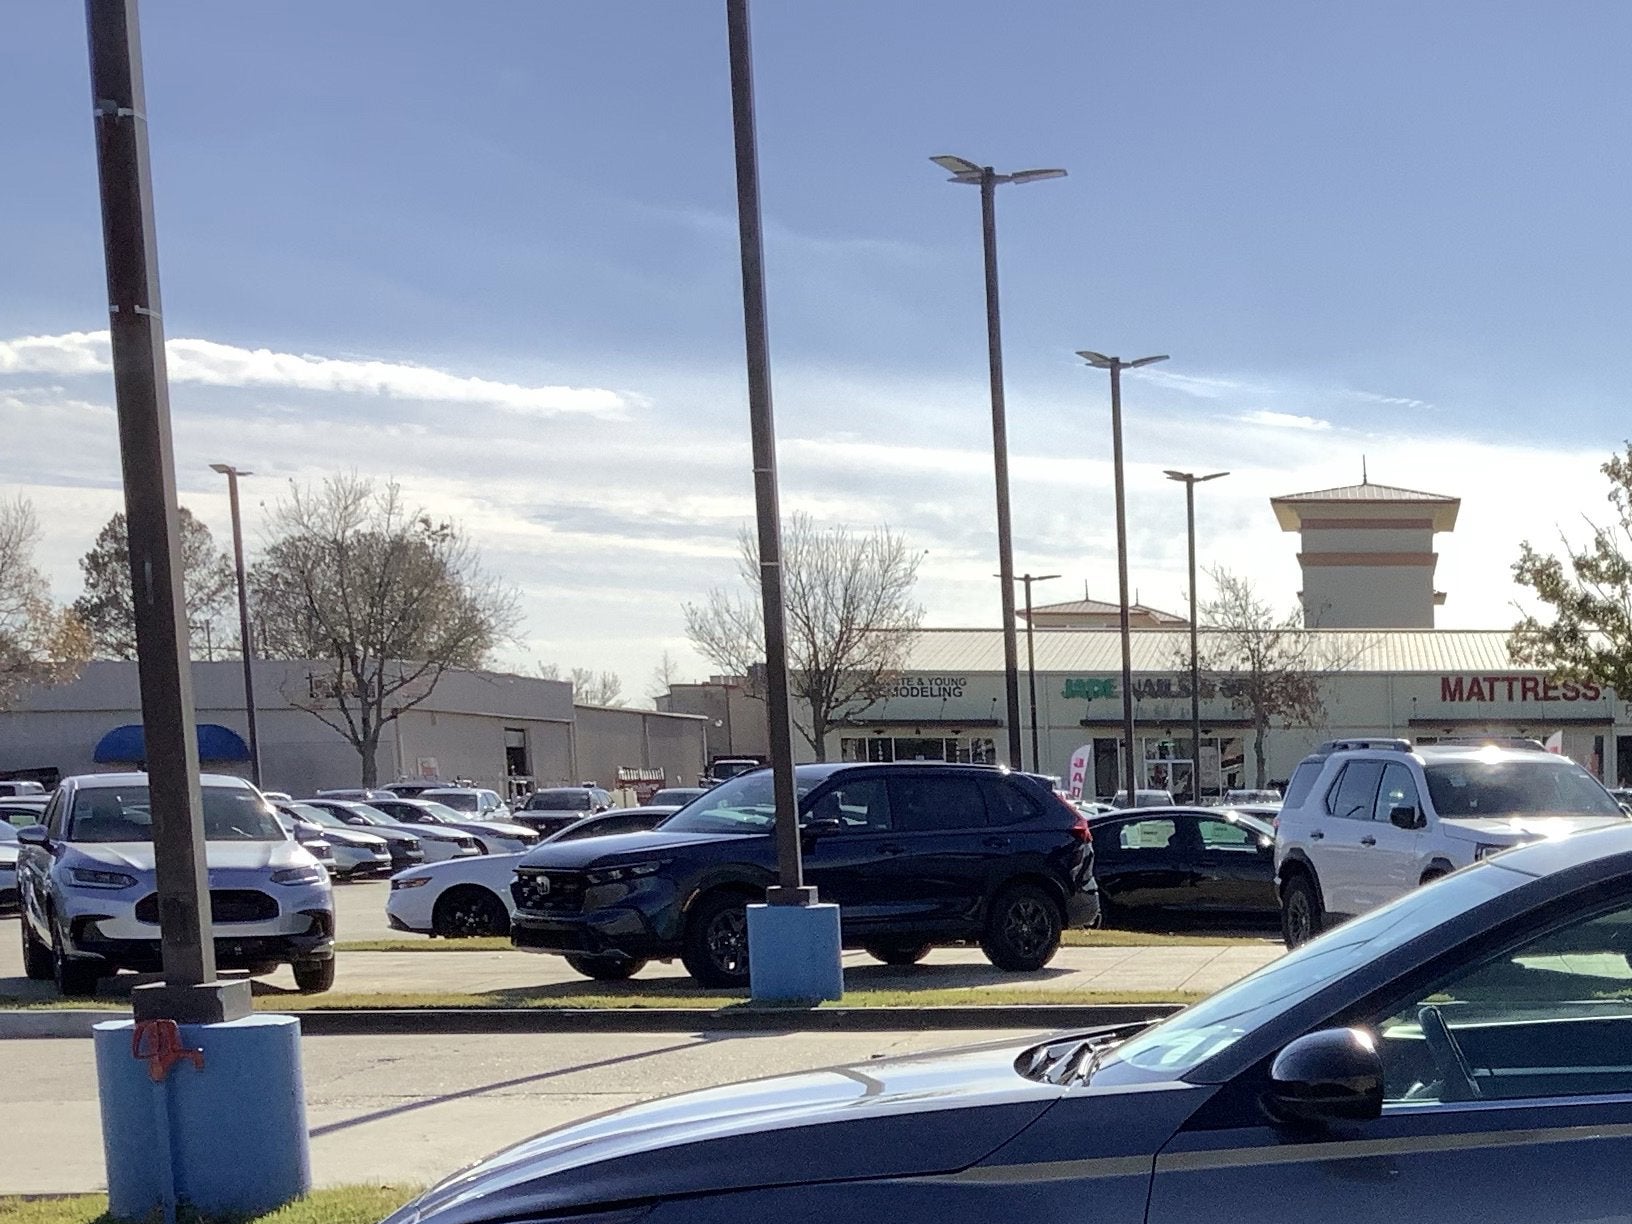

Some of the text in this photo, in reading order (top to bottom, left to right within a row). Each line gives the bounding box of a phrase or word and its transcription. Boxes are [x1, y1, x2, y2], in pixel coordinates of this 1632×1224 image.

[928, 678, 967, 686] YOUNG
[878, 687, 963, 697] MODELING
[1440, 676, 1601, 701] MATTRESS
